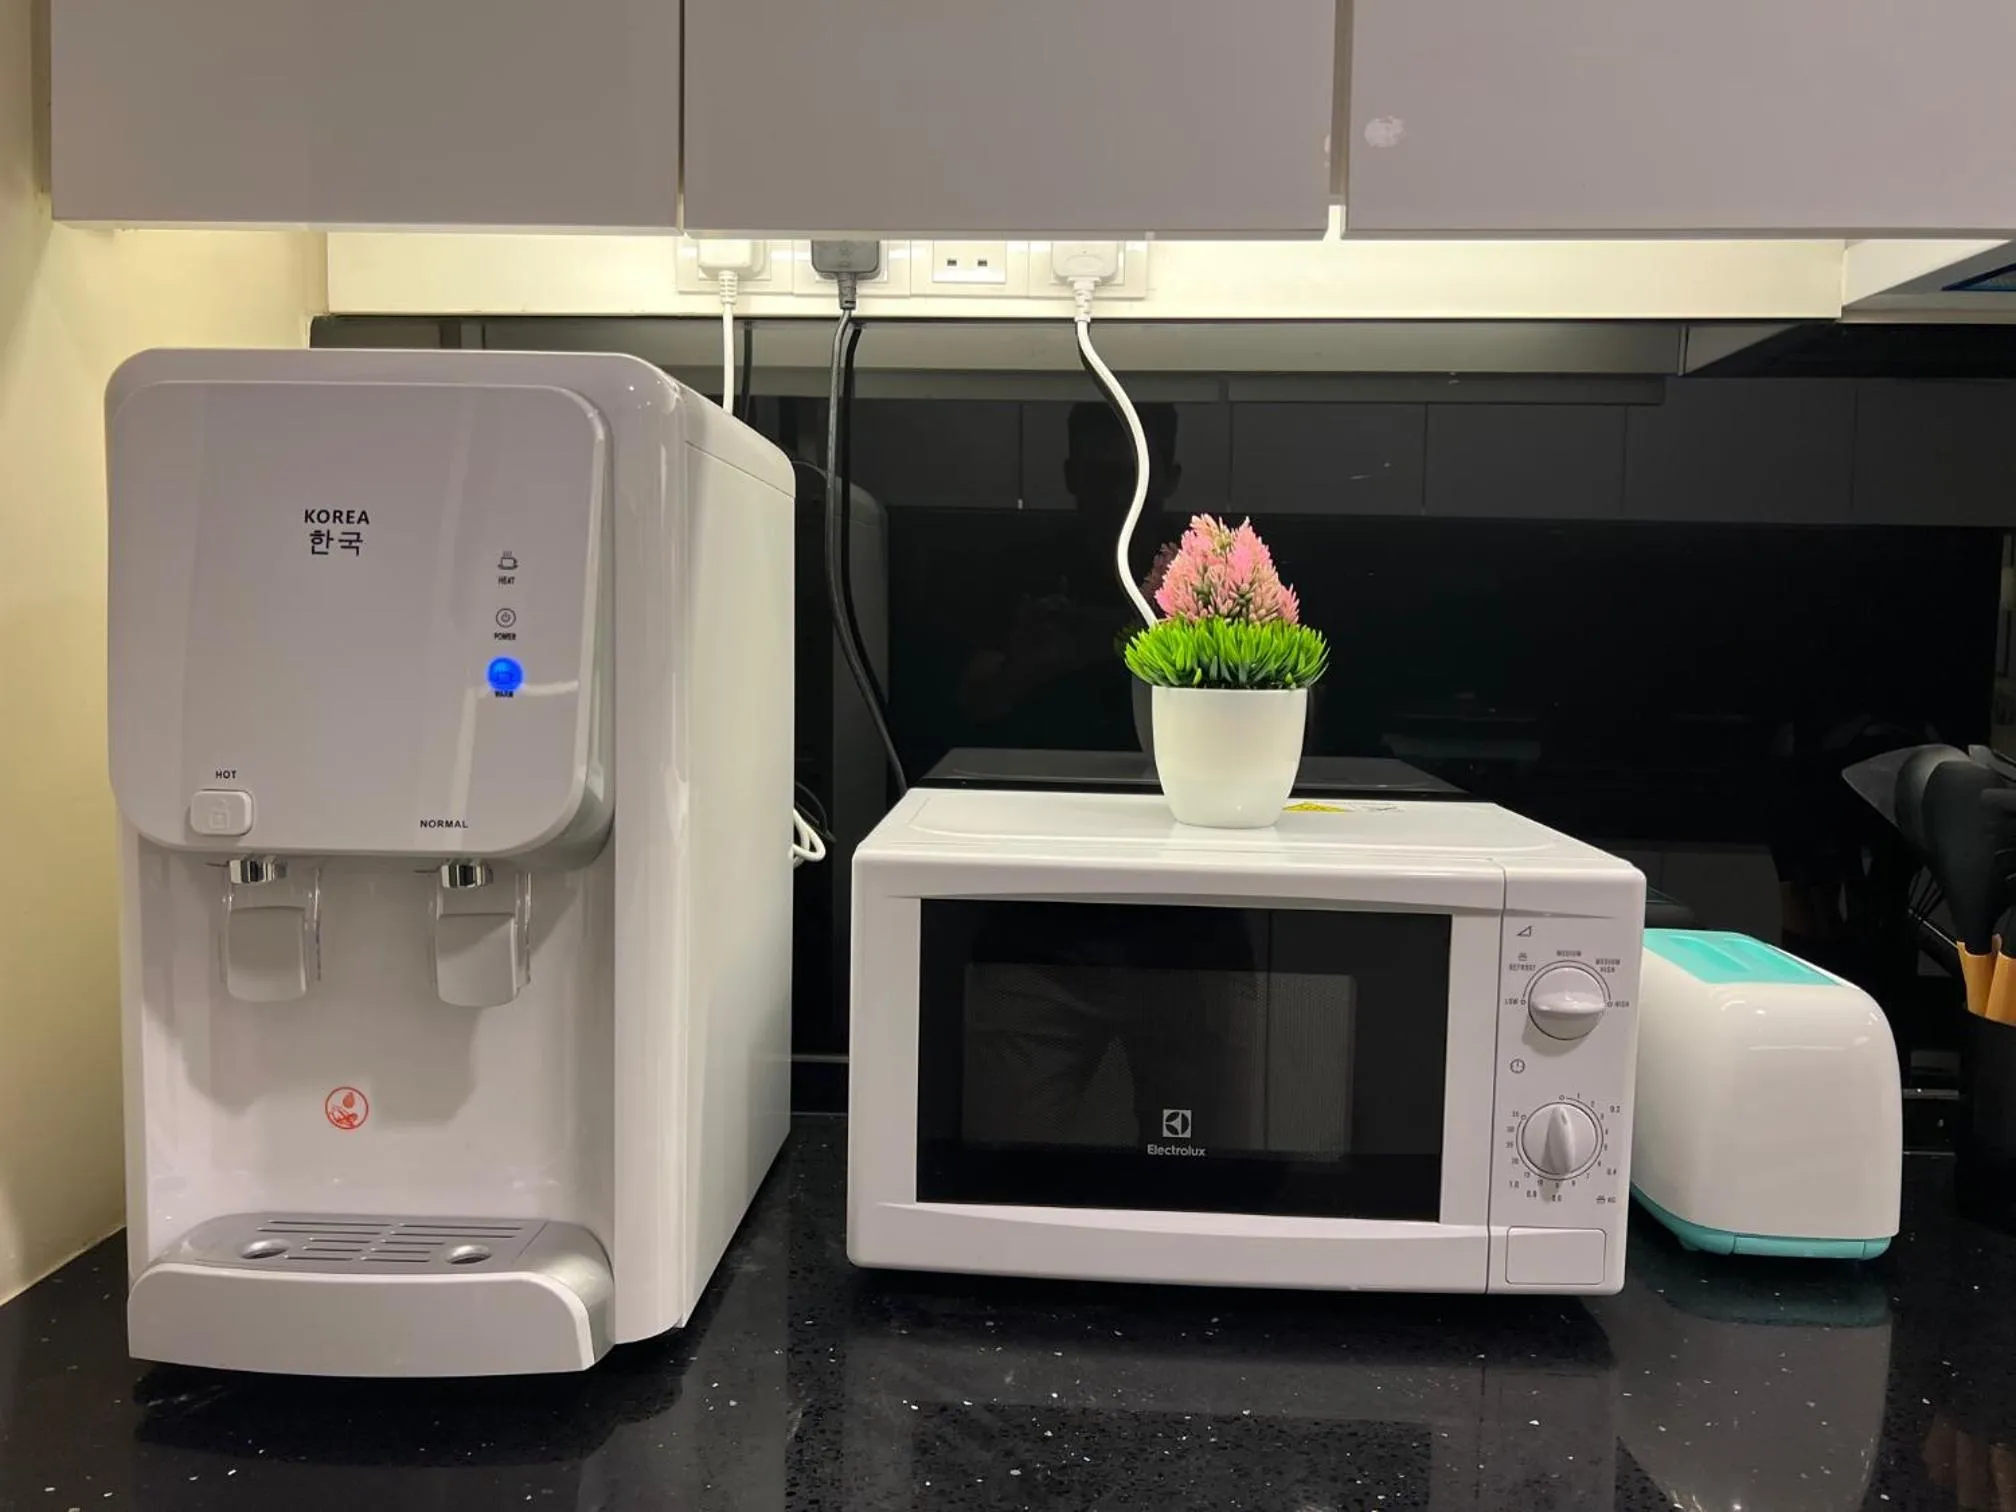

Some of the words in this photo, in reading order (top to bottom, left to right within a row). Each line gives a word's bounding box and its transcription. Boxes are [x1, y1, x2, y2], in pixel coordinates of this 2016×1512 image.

[304, 509, 370, 525] KOREA
[309, 529, 363, 556] 한국
[498, 576, 515, 585] HEAT
[494, 632, 516, 641] POWER
[215, 770, 237, 780] HOT
[419, 819, 468, 829] NORMAL
[1147, 1144, 1206, 1156] Electrolux
